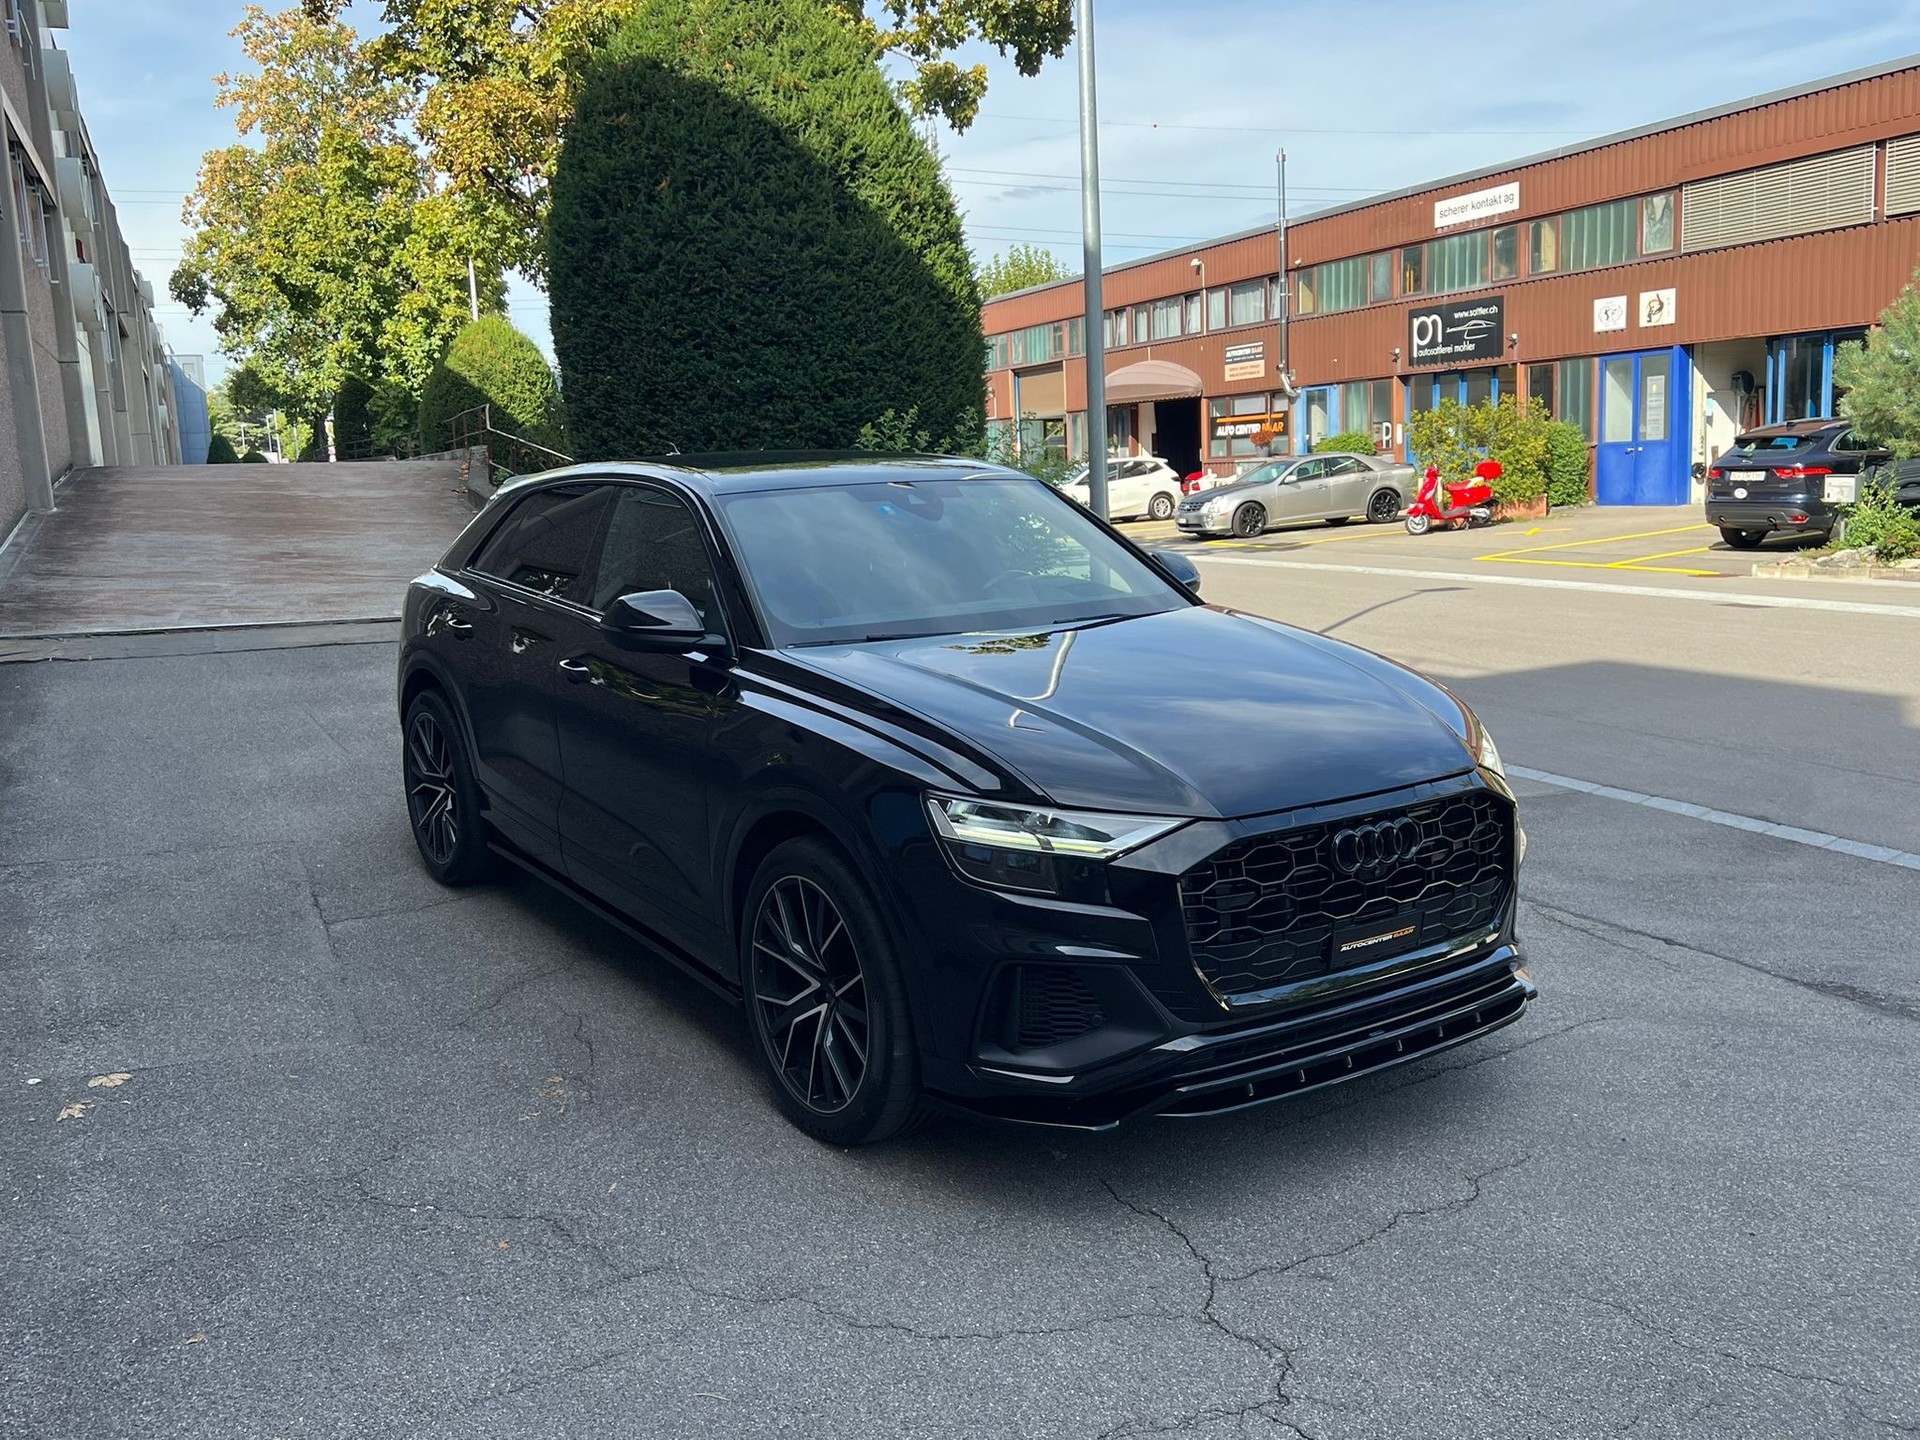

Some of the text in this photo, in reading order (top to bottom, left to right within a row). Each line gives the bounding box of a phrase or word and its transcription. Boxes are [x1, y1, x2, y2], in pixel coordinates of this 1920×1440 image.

[1439, 193, 1515, 219] scherer kontakt ag
[1454, 340, 1476, 353] mohler
[1216, 424, 1235, 437] AUTO
[1235, 422, 1261, 435] CENTER
[1340, 934, 1393, 952] AUTOCENTER
